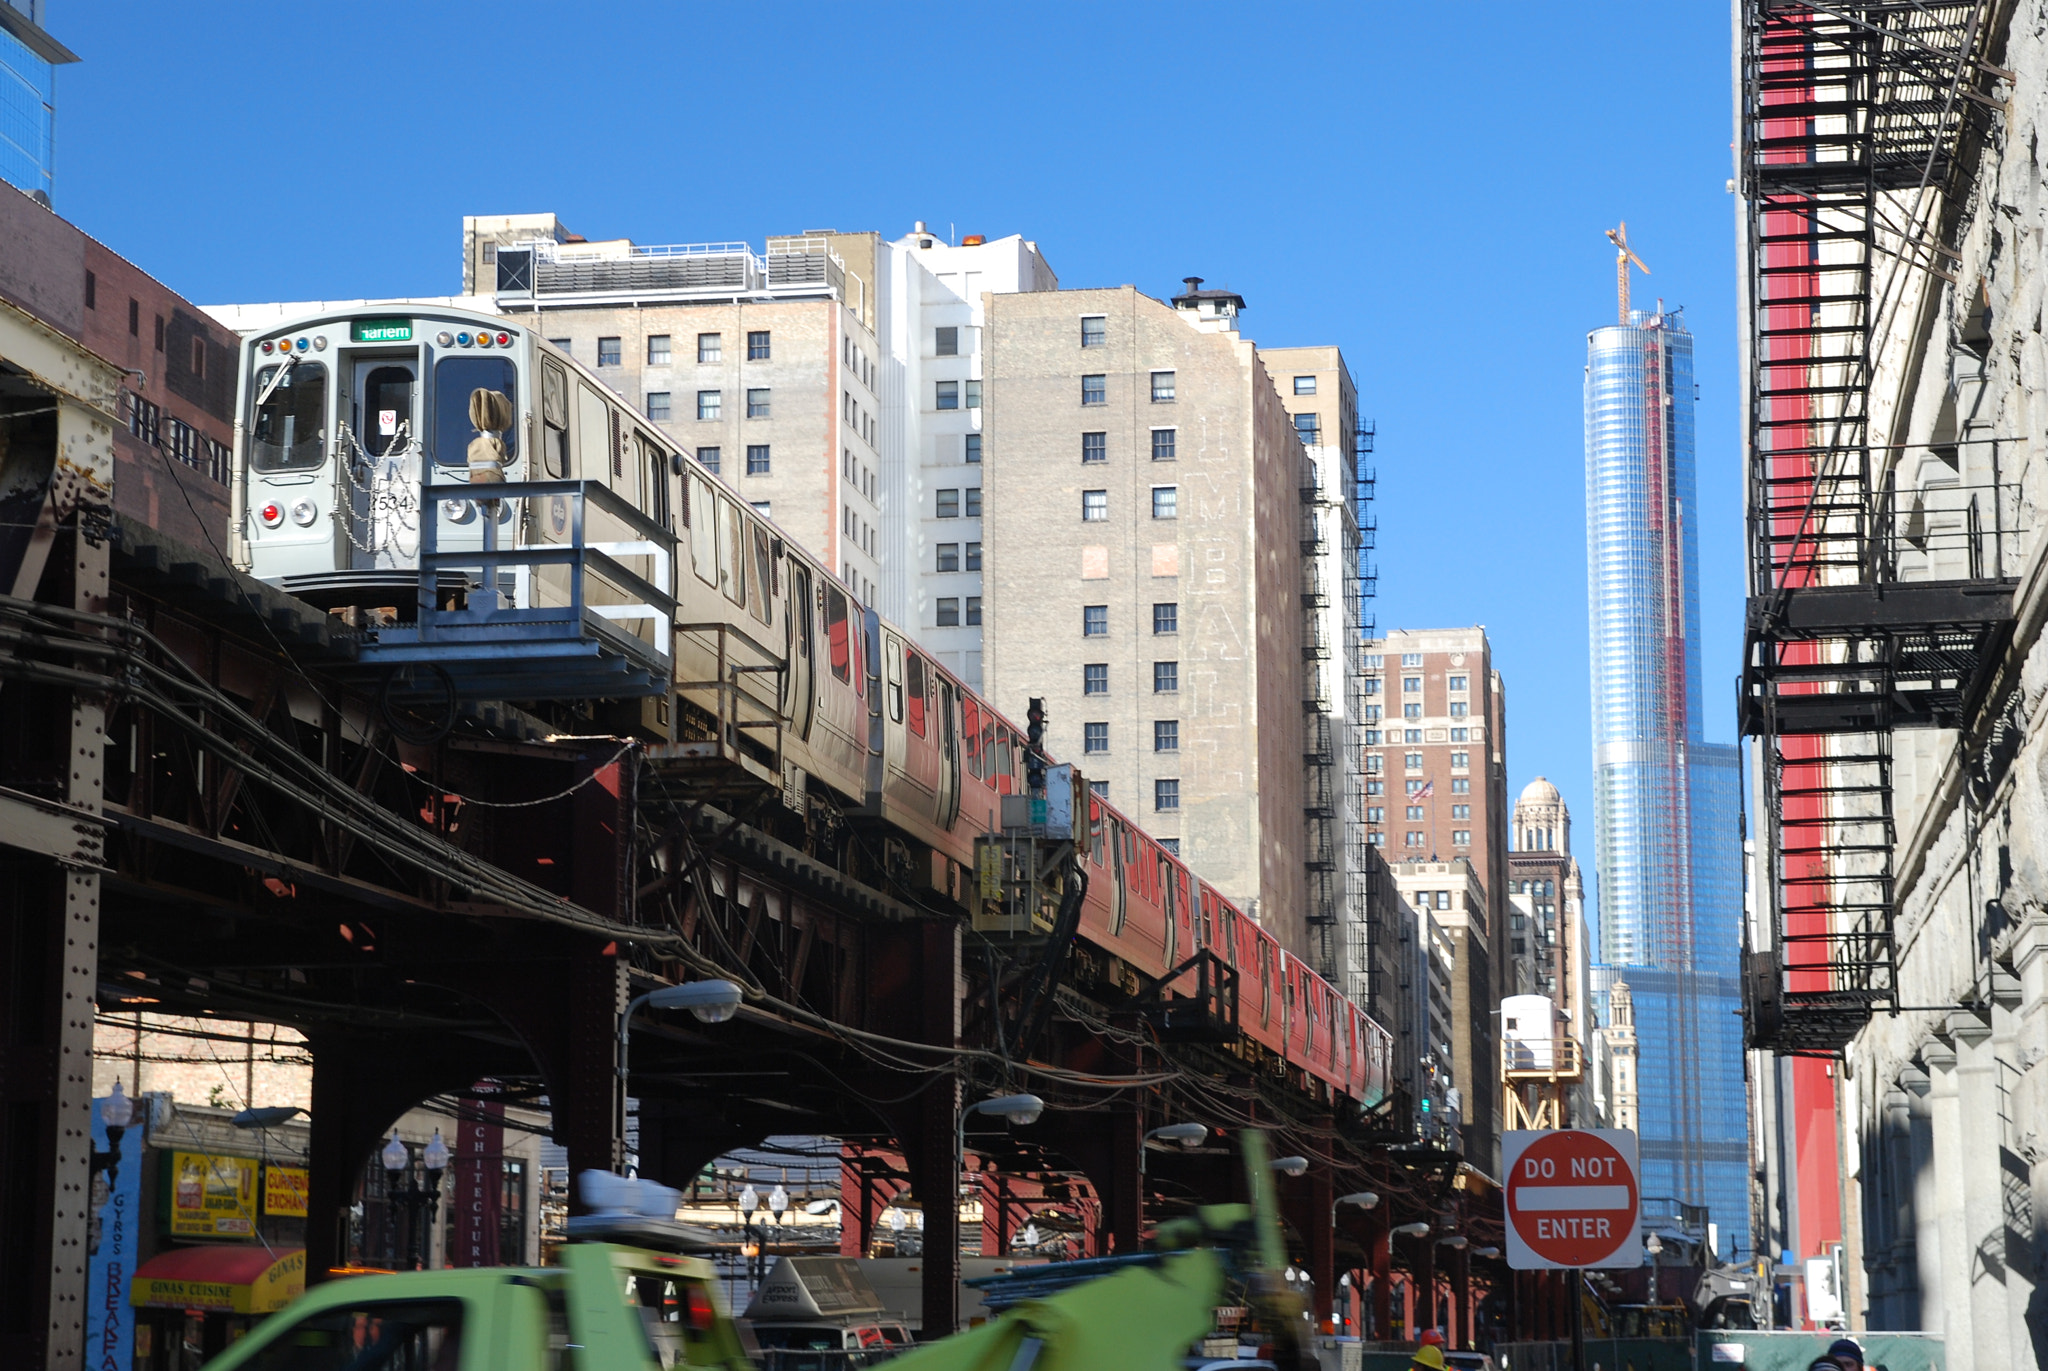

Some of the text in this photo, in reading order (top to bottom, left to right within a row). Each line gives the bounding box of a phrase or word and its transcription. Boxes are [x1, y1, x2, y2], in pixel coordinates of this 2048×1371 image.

[359, 324, 410, 339] Harlem
[1524, 1157, 1617, 1179] DO NOT
[113, 1193, 125, 1256] GYROS
[1537, 1217, 1611, 1239] ENTER
[268, 1254, 304, 1283] GINAS
[151, 1281, 232, 1298] GINAS CUISINE
[101, 1262, 121, 1371] BREAKFA
